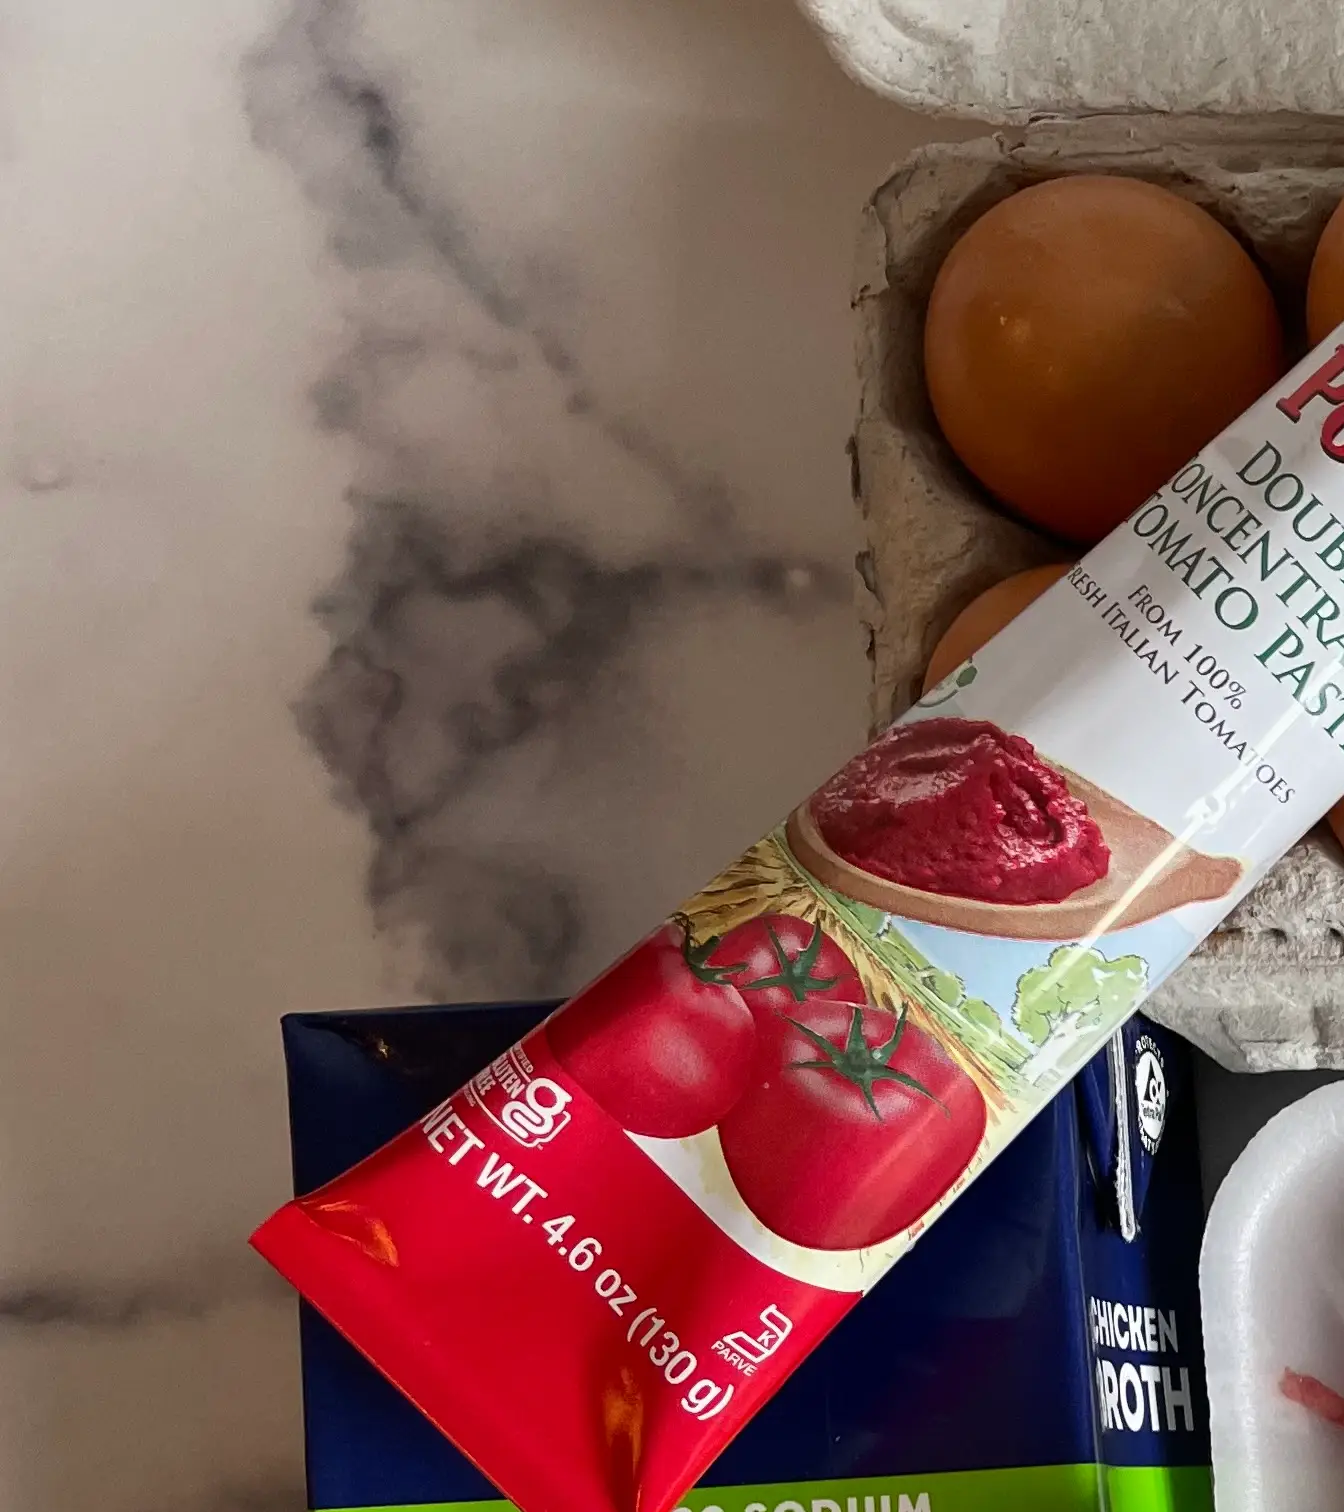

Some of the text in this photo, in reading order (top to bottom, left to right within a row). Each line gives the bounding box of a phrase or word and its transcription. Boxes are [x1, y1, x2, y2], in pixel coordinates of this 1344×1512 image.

[1101, 602, 1180, 685] ITALIAN
[1180, 680, 1296, 804] TOMATOES
[1127, 584, 1247, 711] FROM 100%
[420, 1098, 486, 1166] NET
[476, 1152, 548, 1224] WT.
[540, 1212, 603, 1273] 4.6
[626, 1305, 697, 1385] (130
[681, 1383, 735, 1421] g)
[710, 1339, 757, 1378] PARVE
